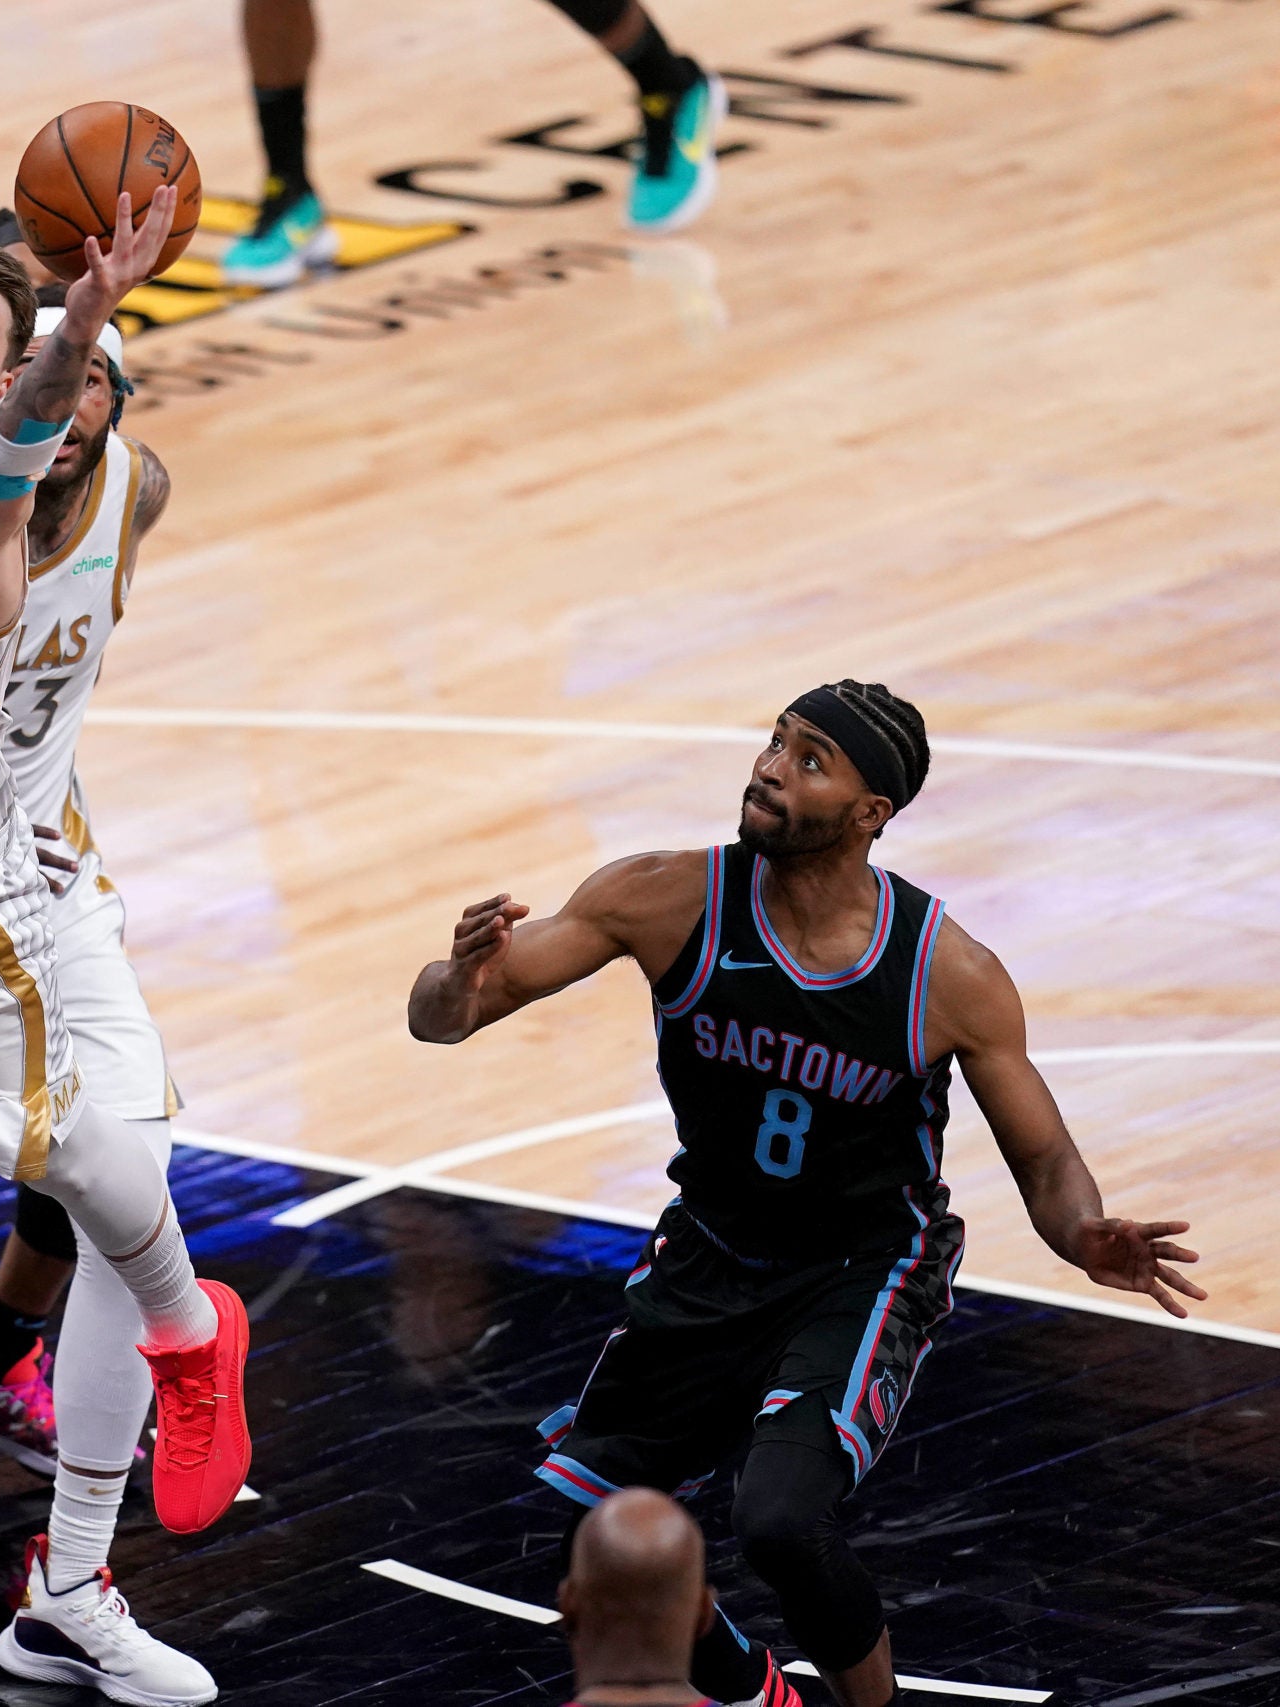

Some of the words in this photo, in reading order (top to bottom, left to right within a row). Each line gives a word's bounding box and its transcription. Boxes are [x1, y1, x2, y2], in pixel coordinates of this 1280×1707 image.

[375, 0, 1265, 210] CENTE
[72, 554, 114, 575] chime
[12, 614, 92, 673] LAS
[693, 1013, 904, 1105] SACTOWN
[754, 1088, 813, 1179] 8
